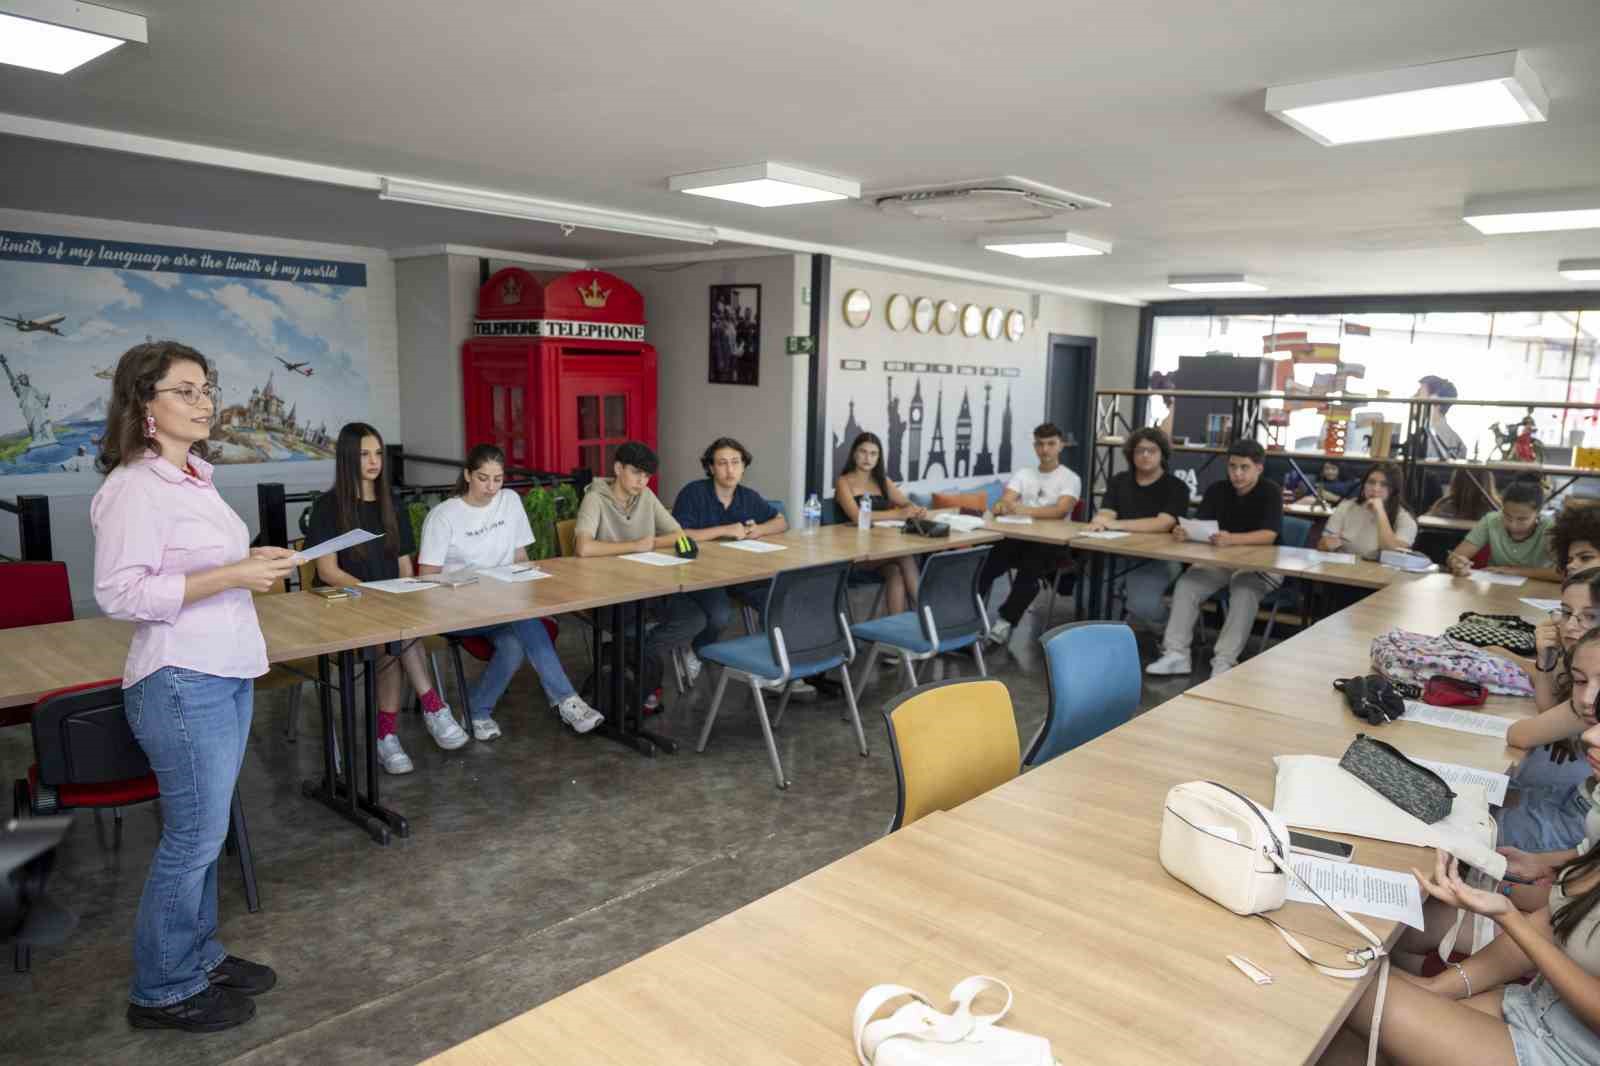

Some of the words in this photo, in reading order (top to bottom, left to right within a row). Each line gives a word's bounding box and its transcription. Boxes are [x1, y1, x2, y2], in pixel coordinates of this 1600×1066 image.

[0, 236, 43, 255] limits
[48, 241, 66, 260] of
[69, 245, 96, 266] my
[98, 245, 172, 271] language
[173, 253, 198, 268] are
[200, 254, 225, 269] the
[226, 255, 262, 273] limits
[264, 259, 279, 276] of
[281, 265, 301, 281] my
[303, 265, 338, 278] world
[546, 321, 646, 341] TELEPHONE
